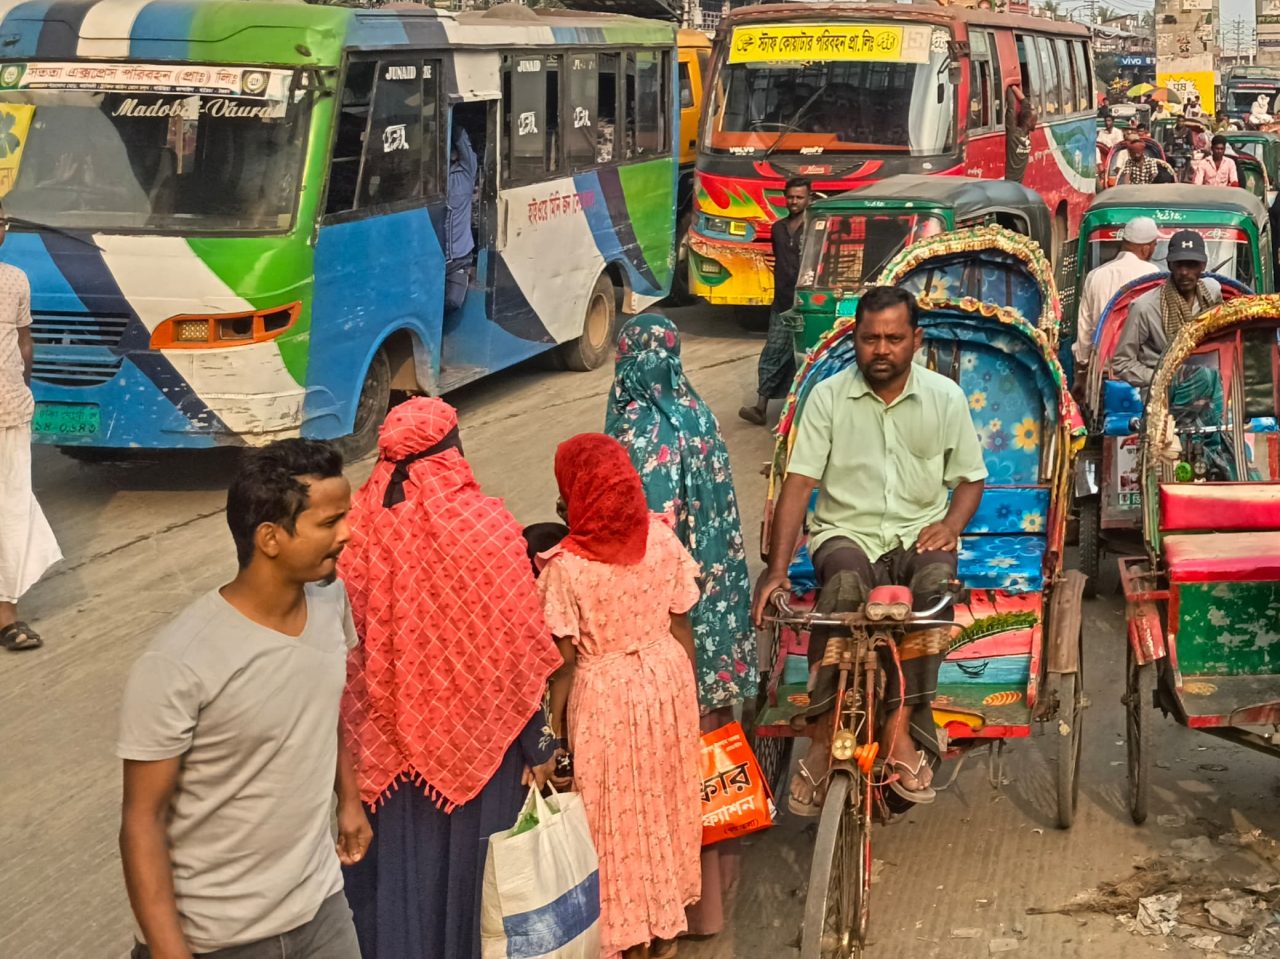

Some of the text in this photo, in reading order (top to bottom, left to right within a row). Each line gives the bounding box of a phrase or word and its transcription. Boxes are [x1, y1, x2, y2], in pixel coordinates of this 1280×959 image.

[758, 32, 779, 53] স্টাফ
[815, 29, 847, 53] পরিবহন
[517, 60, 541, 72] JUNAID
[1121, 57, 1141, 65] vivo
[28, 67, 63, 78] সততা
[121, 66, 171, 81] পরিবহন
[386, 66, 417, 80] JUNAID
[703, 795, 755, 826] ফ্যাশন
